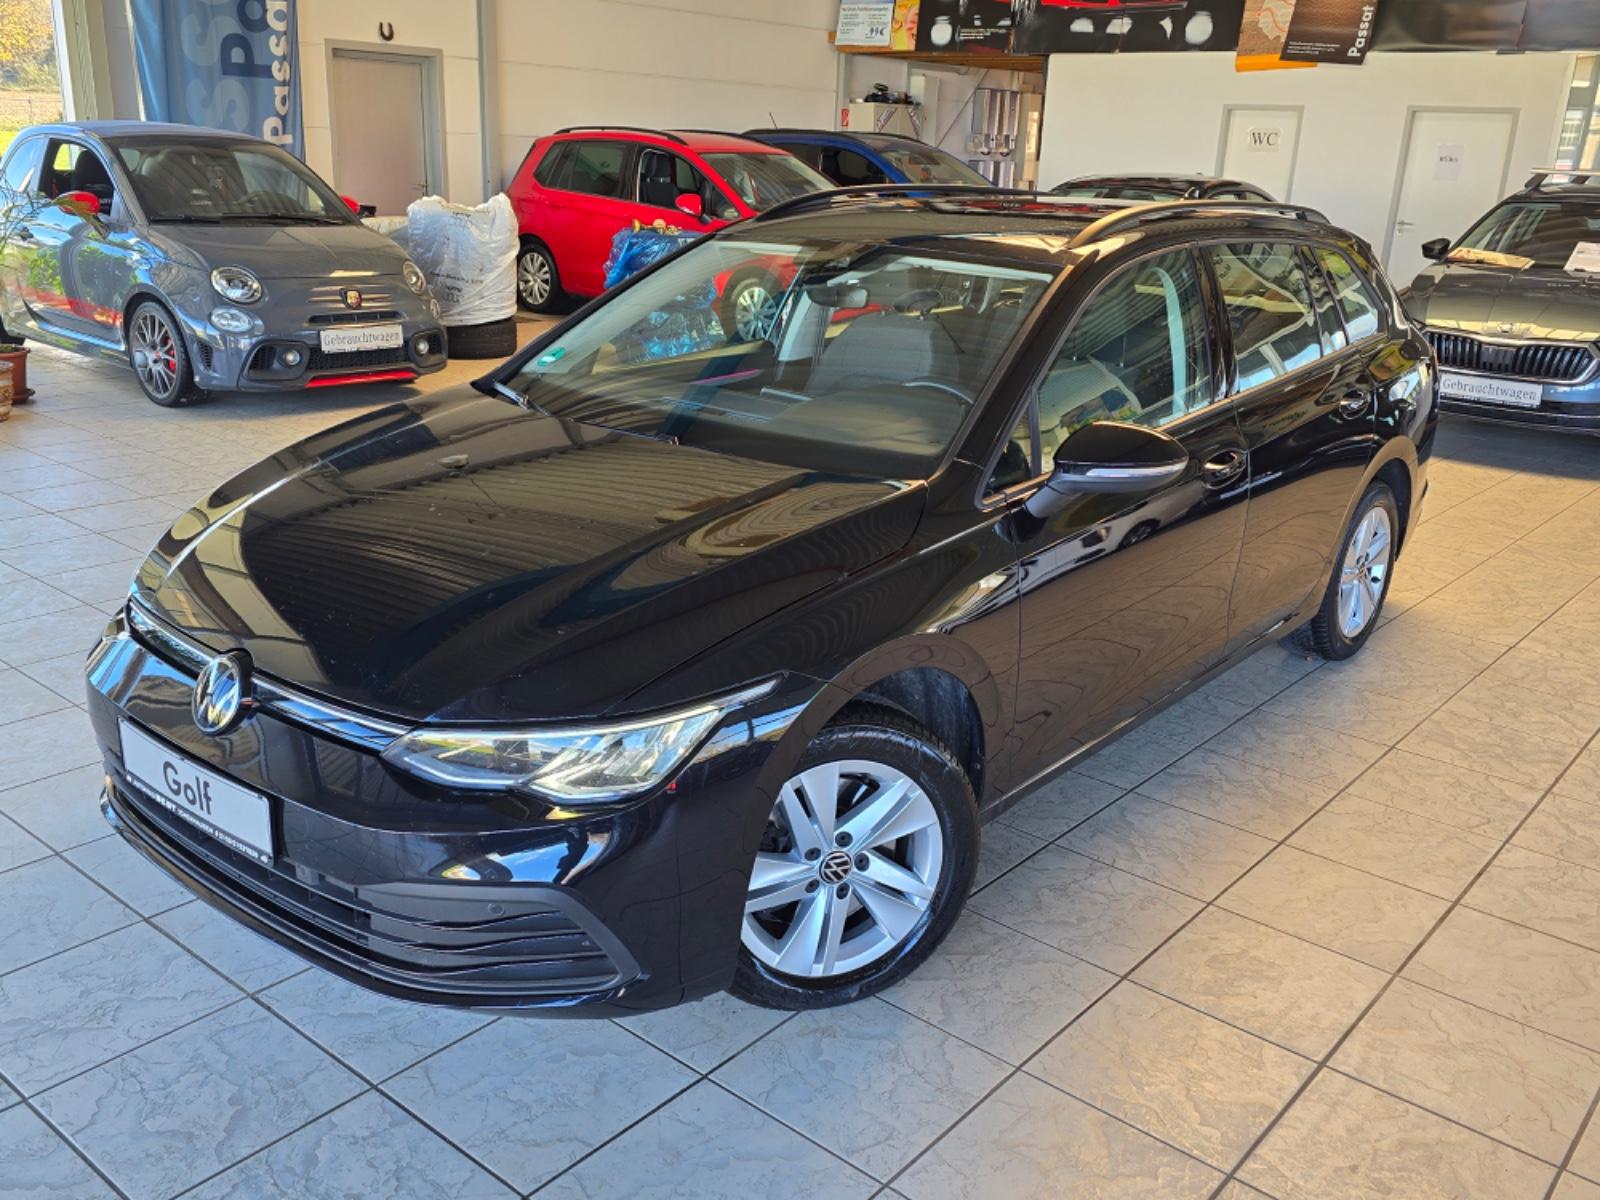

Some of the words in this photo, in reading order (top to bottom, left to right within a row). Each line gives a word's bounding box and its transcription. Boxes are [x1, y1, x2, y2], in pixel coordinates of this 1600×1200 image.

[1347, 4, 1375, 57] Passat
[1251, 131, 1279, 146] WC
[323, 331, 399, 346] Gebrauchtwagen
[1442, 378, 1537, 401] Gebrauchtwagen
[163, 760, 212, 816] Golf
